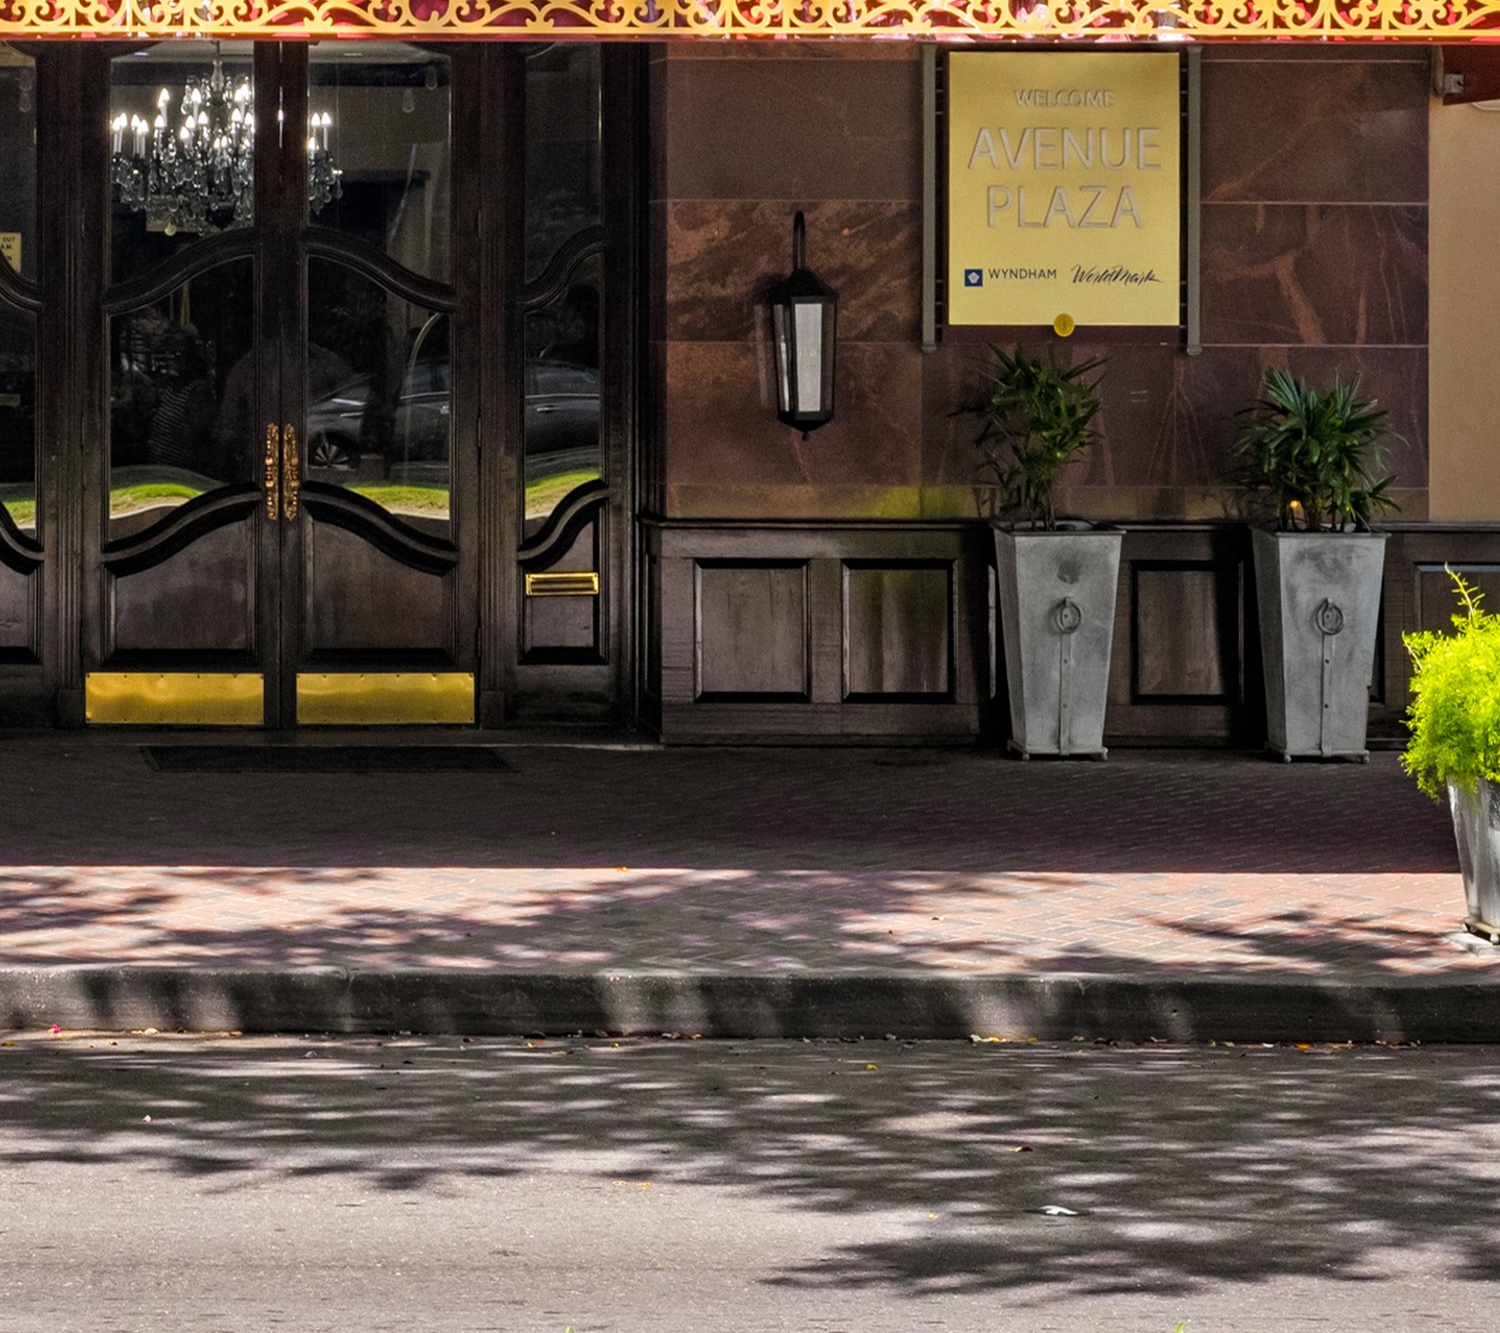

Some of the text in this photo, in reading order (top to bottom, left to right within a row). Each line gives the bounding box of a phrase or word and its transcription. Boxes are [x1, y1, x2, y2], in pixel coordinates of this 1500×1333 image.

[1014, 89, 1114, 107] WELCOME
[967, 127, 1161, 170] AVENUE
[986, 185, 1143, 228] PLAZA
[988, 268, 1057, 280] WYNDHAM
